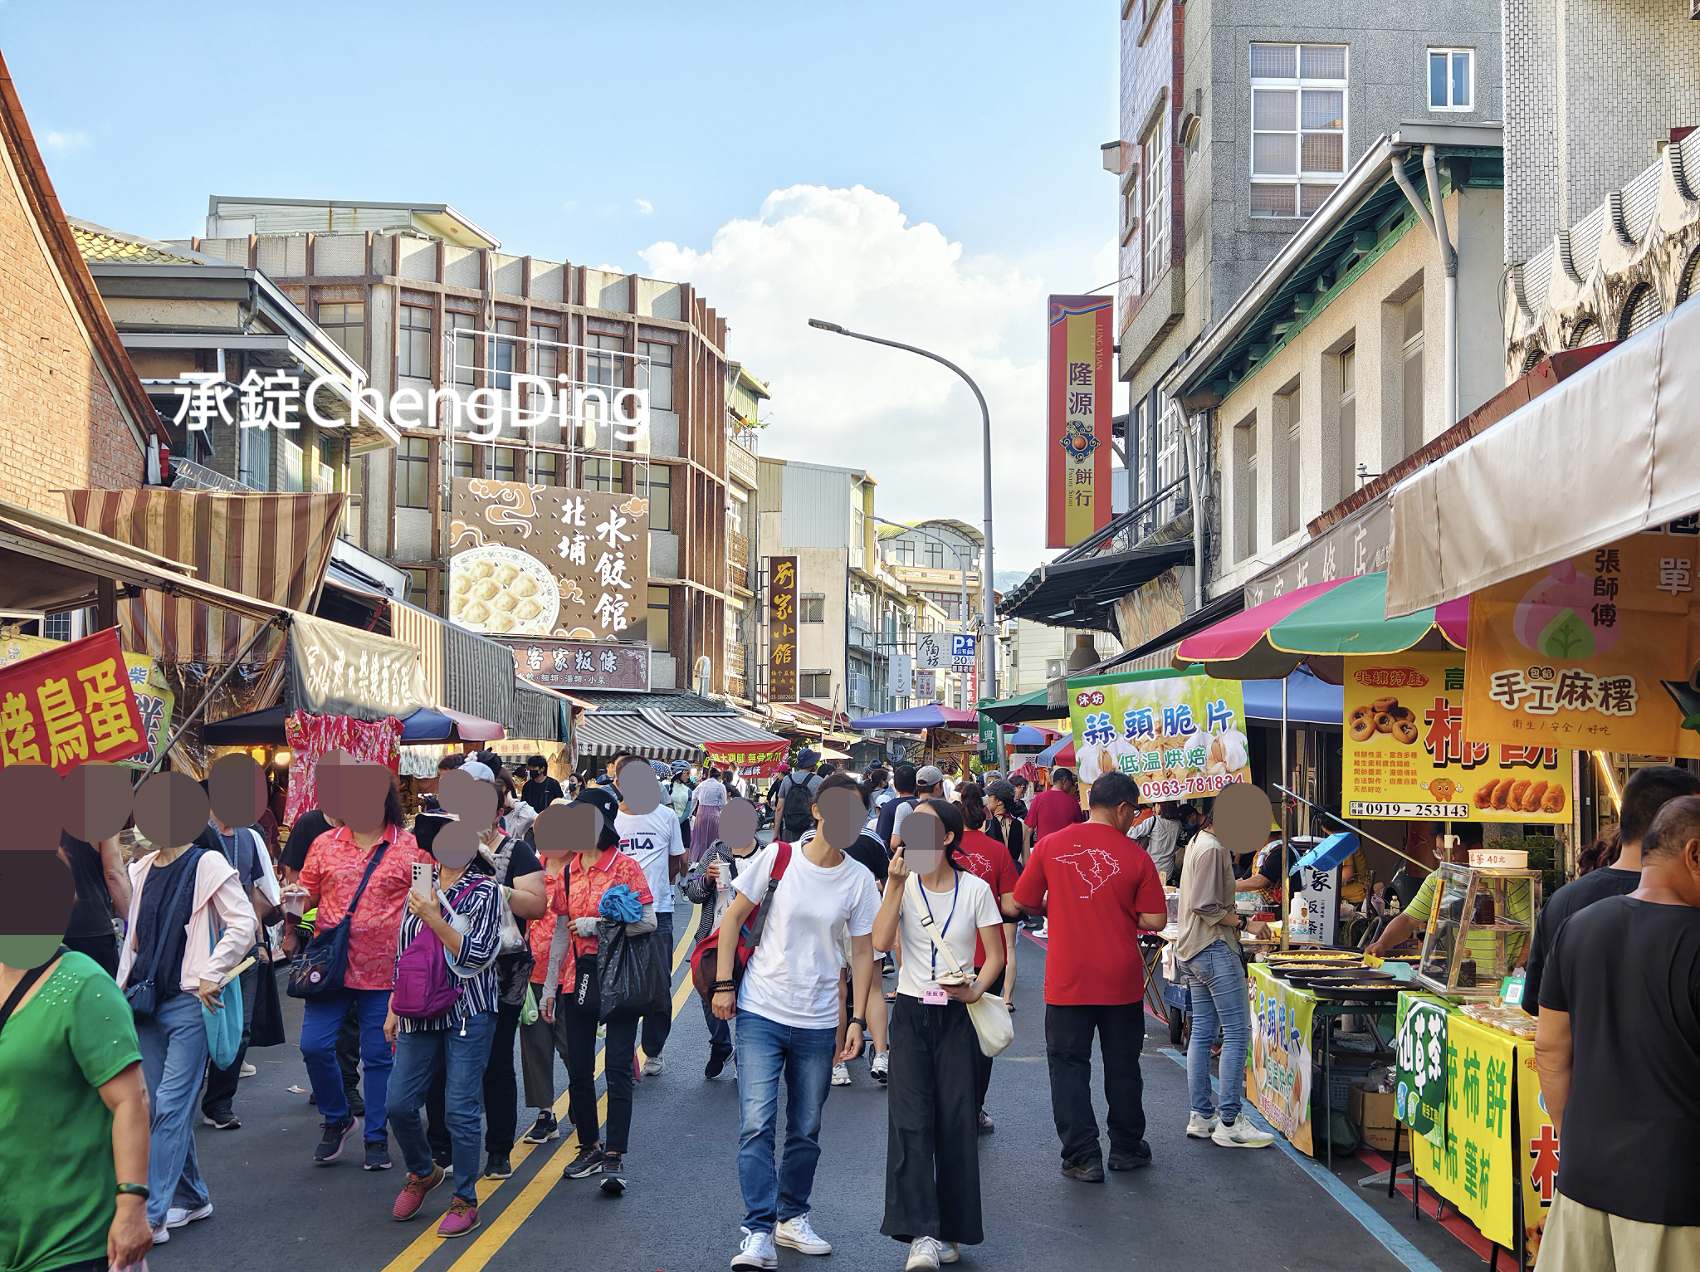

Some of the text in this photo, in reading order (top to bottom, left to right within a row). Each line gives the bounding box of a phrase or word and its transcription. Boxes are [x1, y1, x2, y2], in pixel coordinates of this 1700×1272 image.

[1069, 362, 1093, 507] 隆源 餅行
[557, 496, 590, 566] 北埔
[594, 509, 632, 631] 水餃館
[1591, 549, 1621, 628] 張師傅
[953, 636, 965, 654] P
[1077, 692, 1104, 706] 沐坊
[1491, 670, 1636, 713] 手工麻糬
[1083, 699, 1234, 747] 蒜頭脆片
[619, 837, 654, 852] FILA
[578, 973, 590, 1005] adidas
